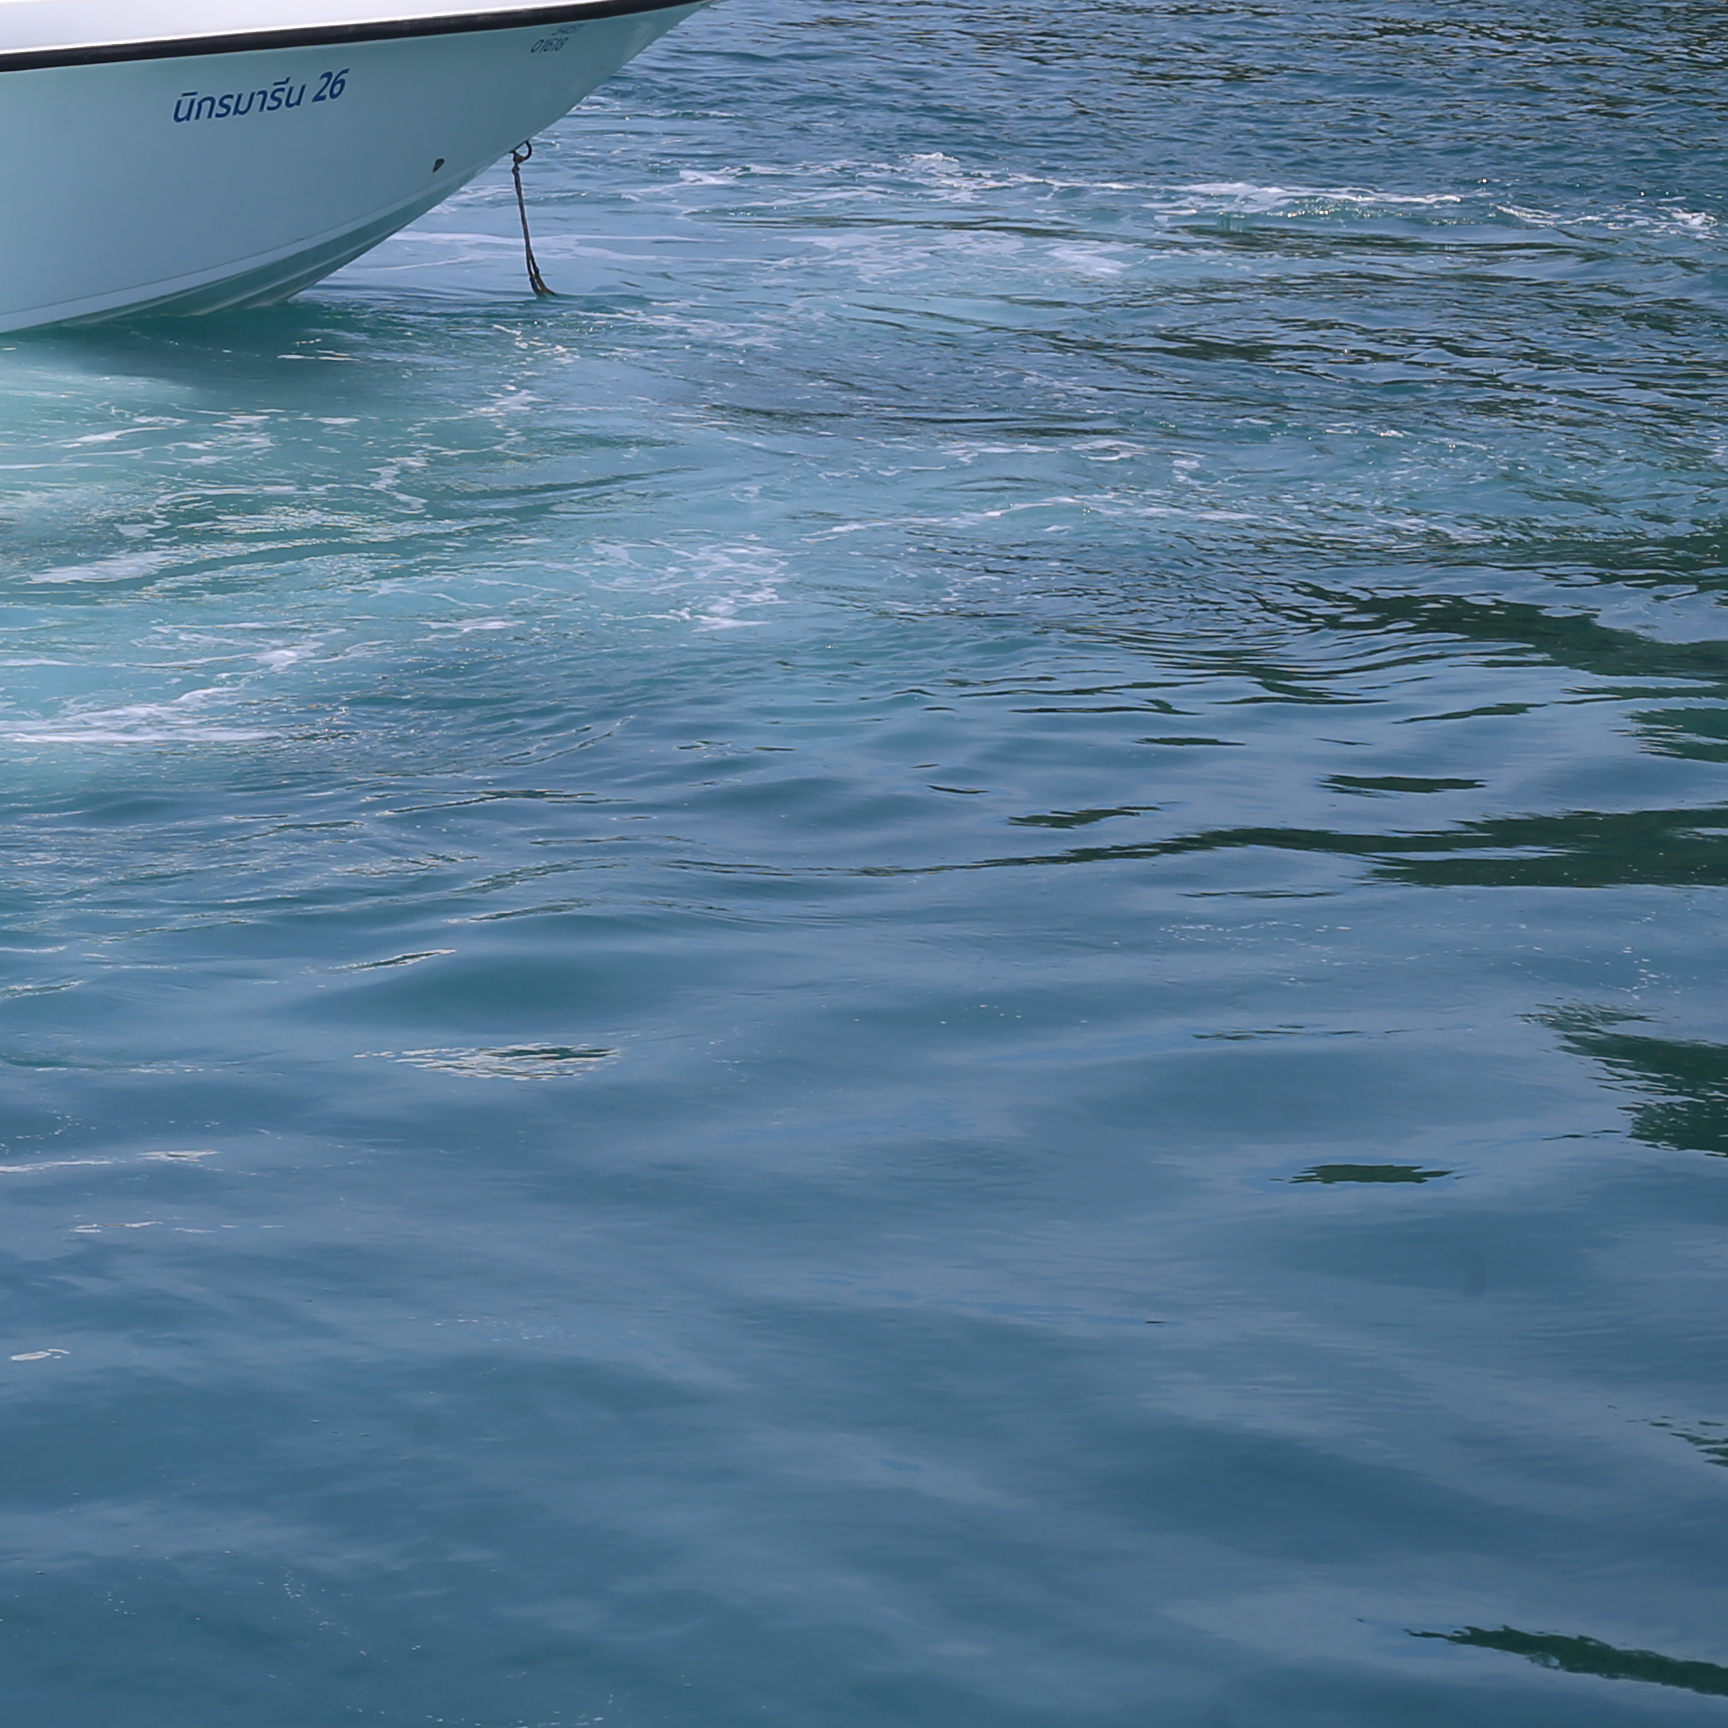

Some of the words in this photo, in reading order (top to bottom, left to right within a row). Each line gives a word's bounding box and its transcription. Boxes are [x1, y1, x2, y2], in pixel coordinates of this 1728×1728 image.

[173, 76, 307, 123] นิกรมารีน
[311, 68, 350, 103] 26
